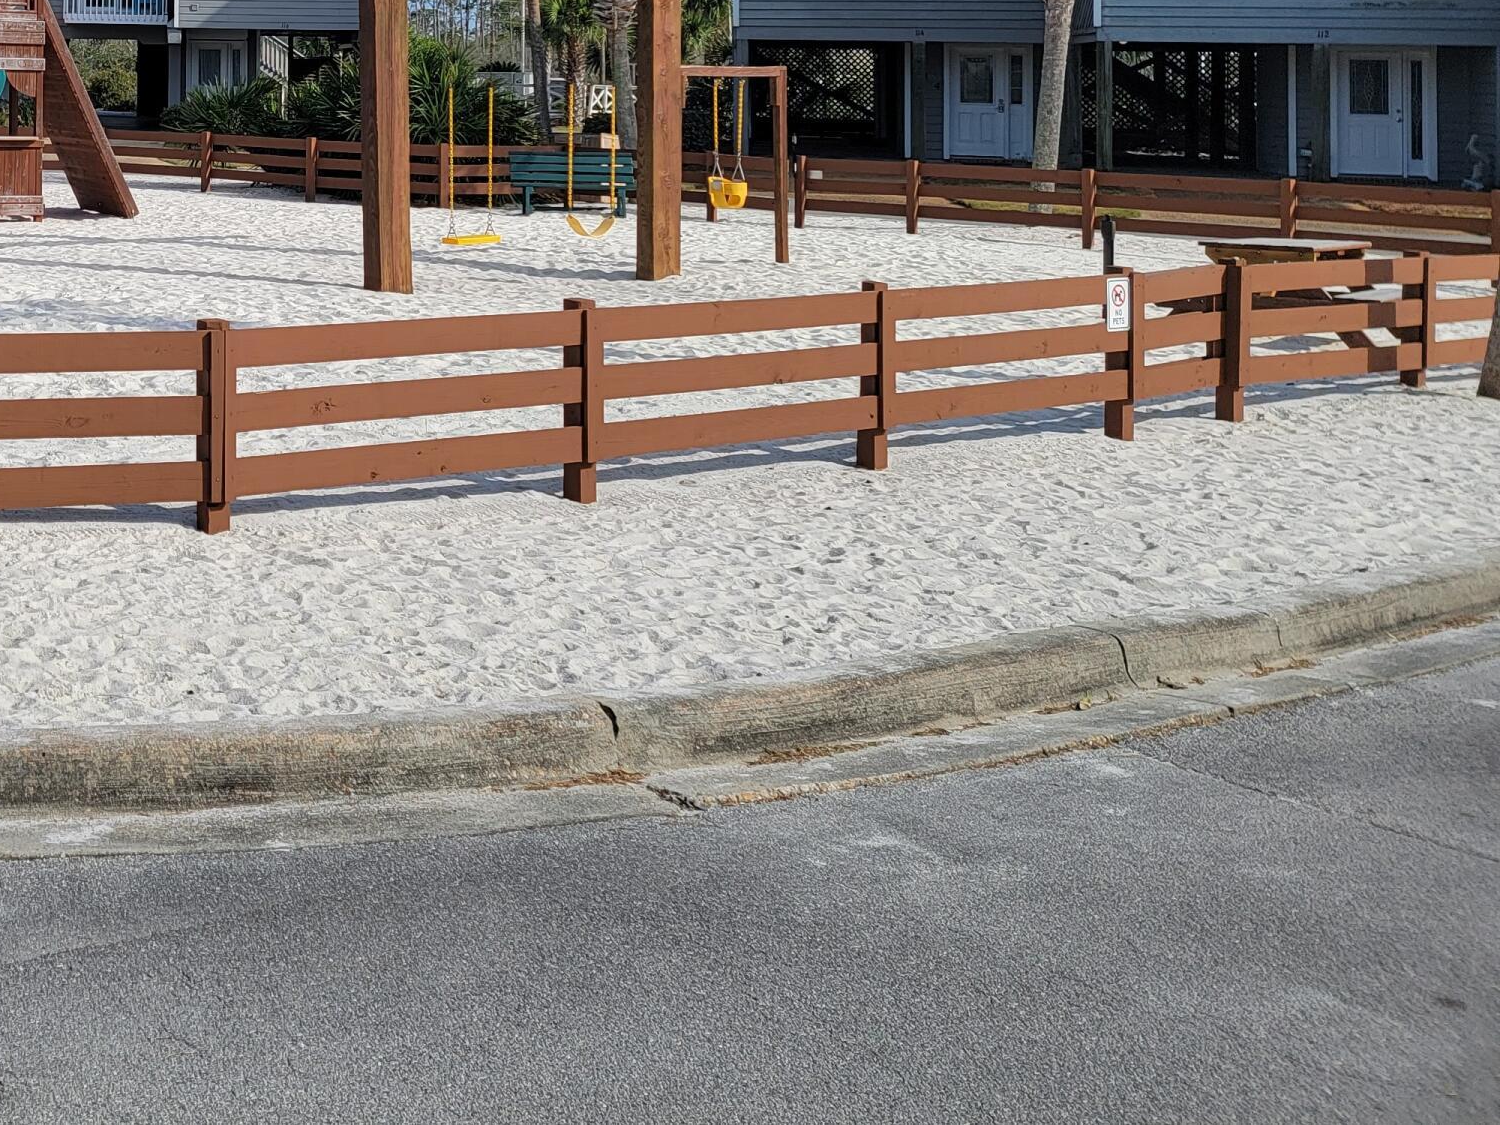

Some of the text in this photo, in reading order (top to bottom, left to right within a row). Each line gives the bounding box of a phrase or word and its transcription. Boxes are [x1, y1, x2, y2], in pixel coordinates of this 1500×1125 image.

[1317, 30, 1330, 38] 112
[1114, 308, 1123, 316] NO
[1112, 317, 1125, 325] PETS
